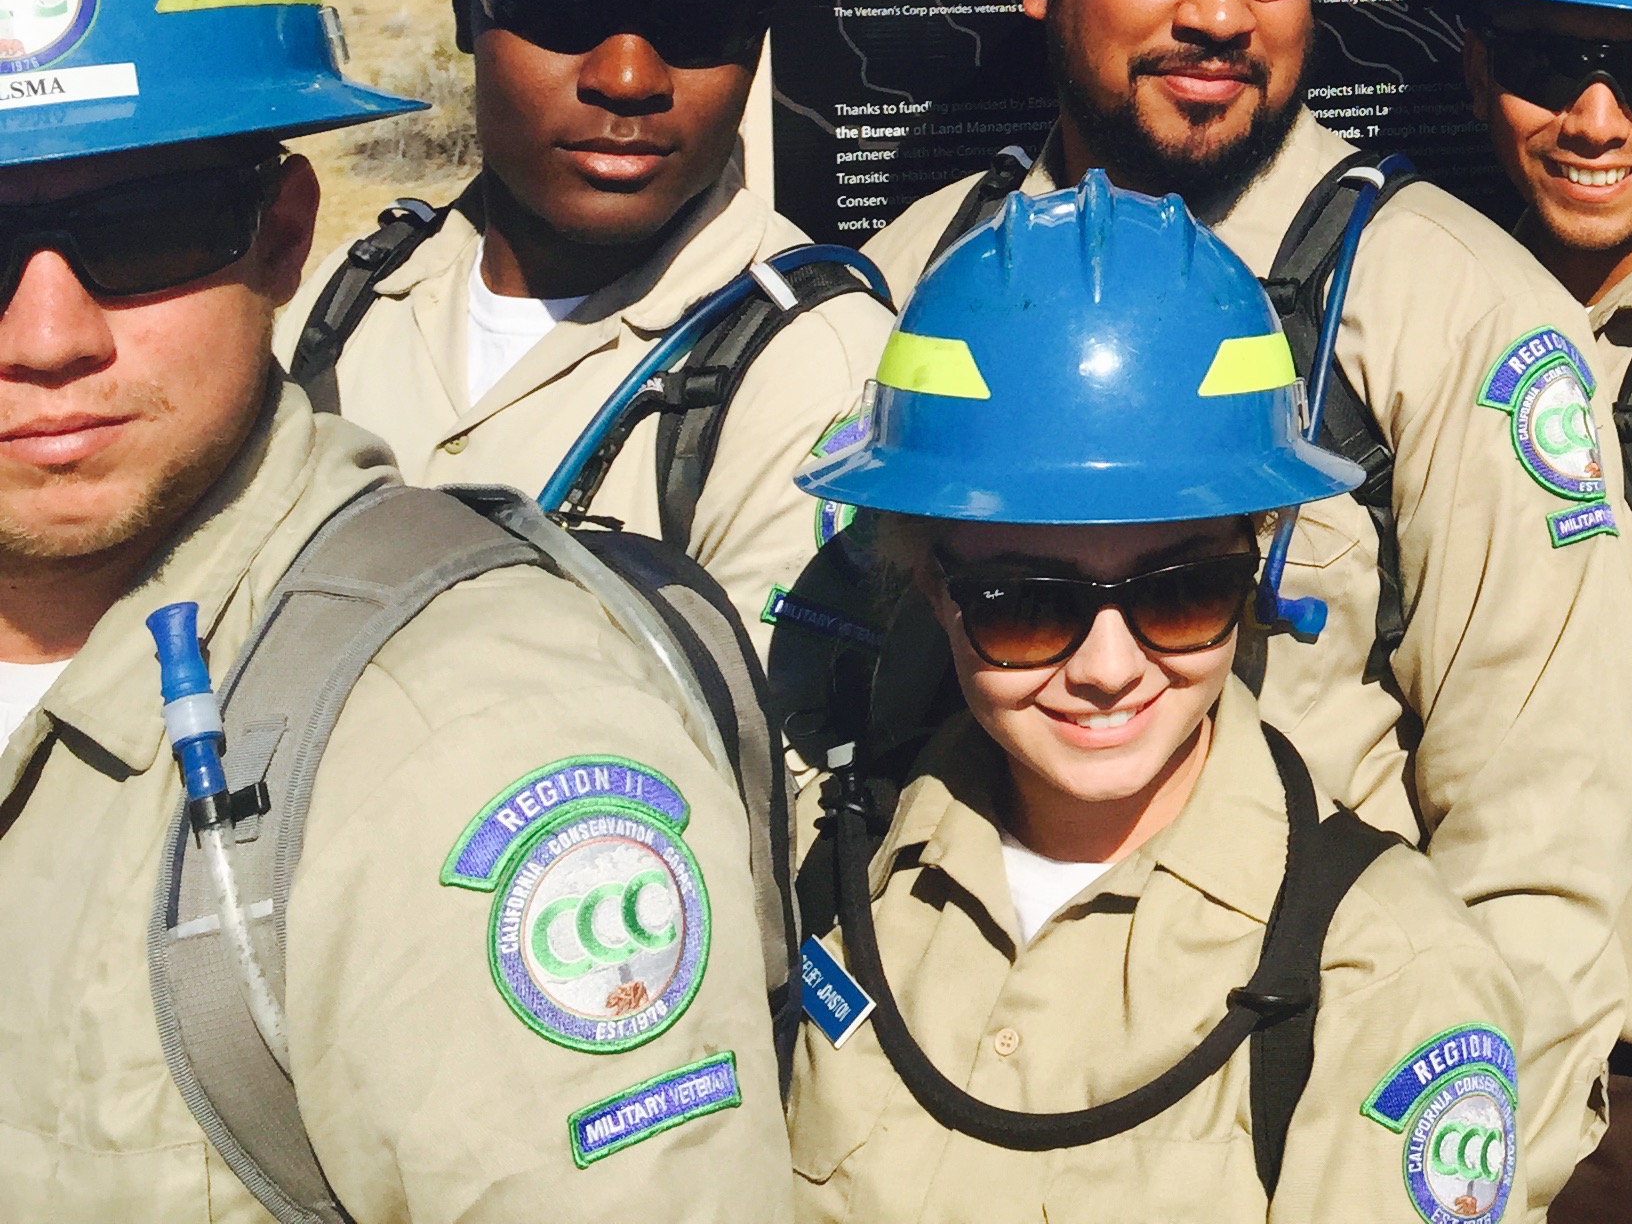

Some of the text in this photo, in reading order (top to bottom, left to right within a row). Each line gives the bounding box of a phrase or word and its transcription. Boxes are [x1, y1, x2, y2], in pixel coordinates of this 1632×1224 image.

[834, 7, 853, 17] The
[854, 5, 900, 17] Veteran's
[902, 5, 927, 17] Corp
[929, 4, 972, 17] provides
[974, 4, 1017, 14] veterans
[835, 102, 880, 116] Thanks
[883, 103, 897, 115] to
[1308, 82, 1397, 99] projects like this
[1310, 105, 1373, 118] onservation
[836, 126, 858, 139] the
[861, 126, 909, 139] Bureau
[838, 217, 887, 231] work to
[497, 766, 610, 833] REGION
[547, 815, 655, 855] CONSERVATION
[500, 858, 544, 955] CALIFORNIA
[531, 869, 678, 979] CCC
[1412, 1034, 1493, 1086] REGION
[585, 1068, 732, 1145] MILITARY VETERAN
[1408, 1090, 1454, 1174] CALIFORNIA
[1431, 1120, 1503, 1182] CCC
